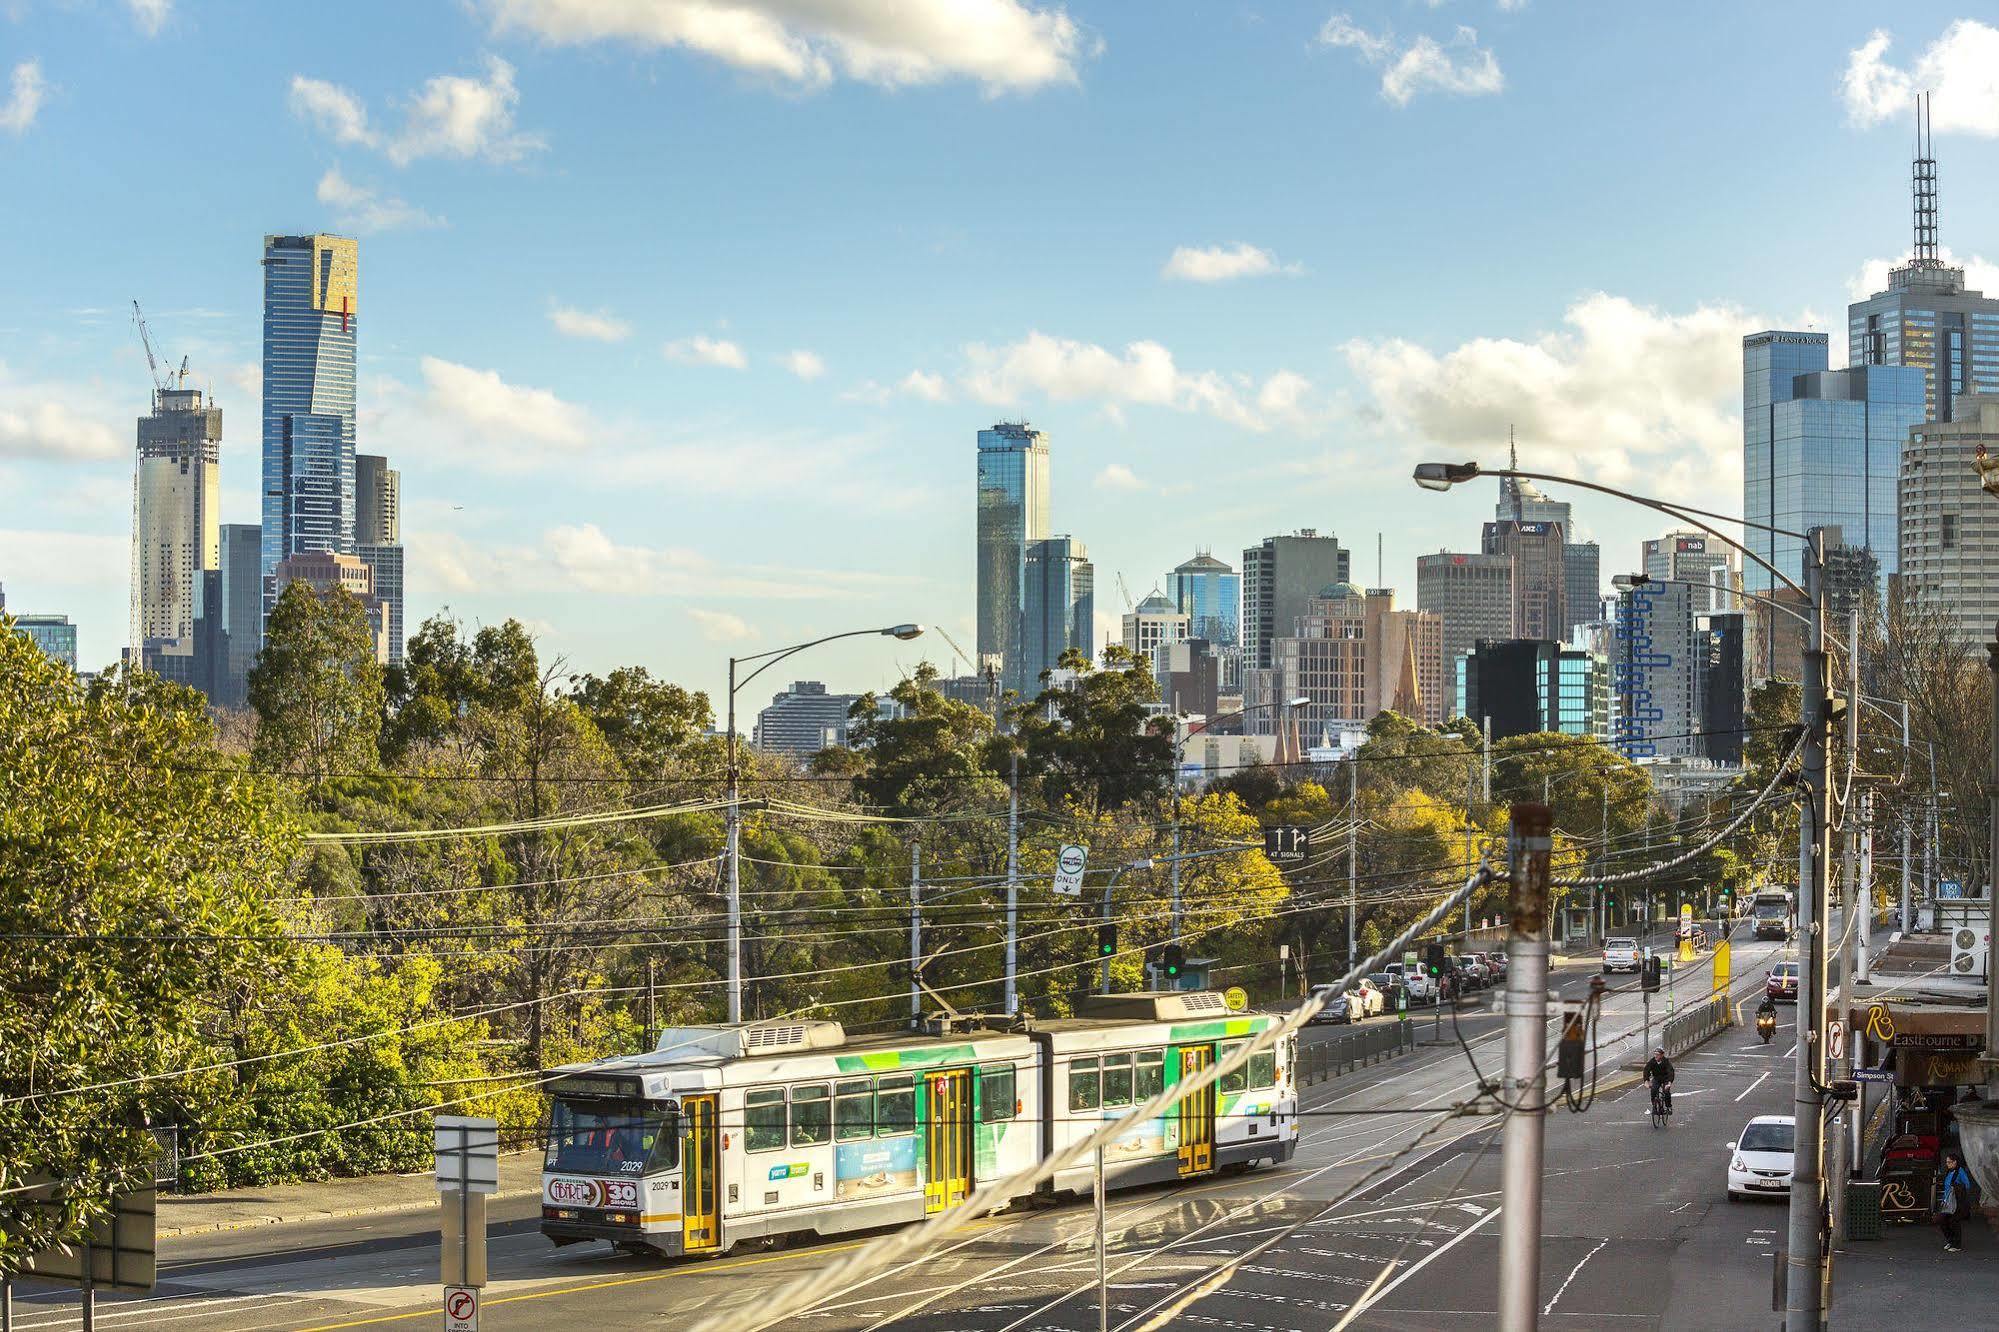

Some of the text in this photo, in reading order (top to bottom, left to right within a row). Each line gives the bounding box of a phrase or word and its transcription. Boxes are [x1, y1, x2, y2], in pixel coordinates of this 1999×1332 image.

[1520, 525, 1536, 533] ANZ
[1687, 541, 1703, 550] nab
[1056, 875, 1081, 884] ONLY
[1856, 1071, 1885, 1080] Simpson
[547, 1158, 558, 1166] PT
[620, 1160, 643, 1172] 2029
[652, 1180, 669, 1191] 2029
[608, 1184, 637, 1201] 30
